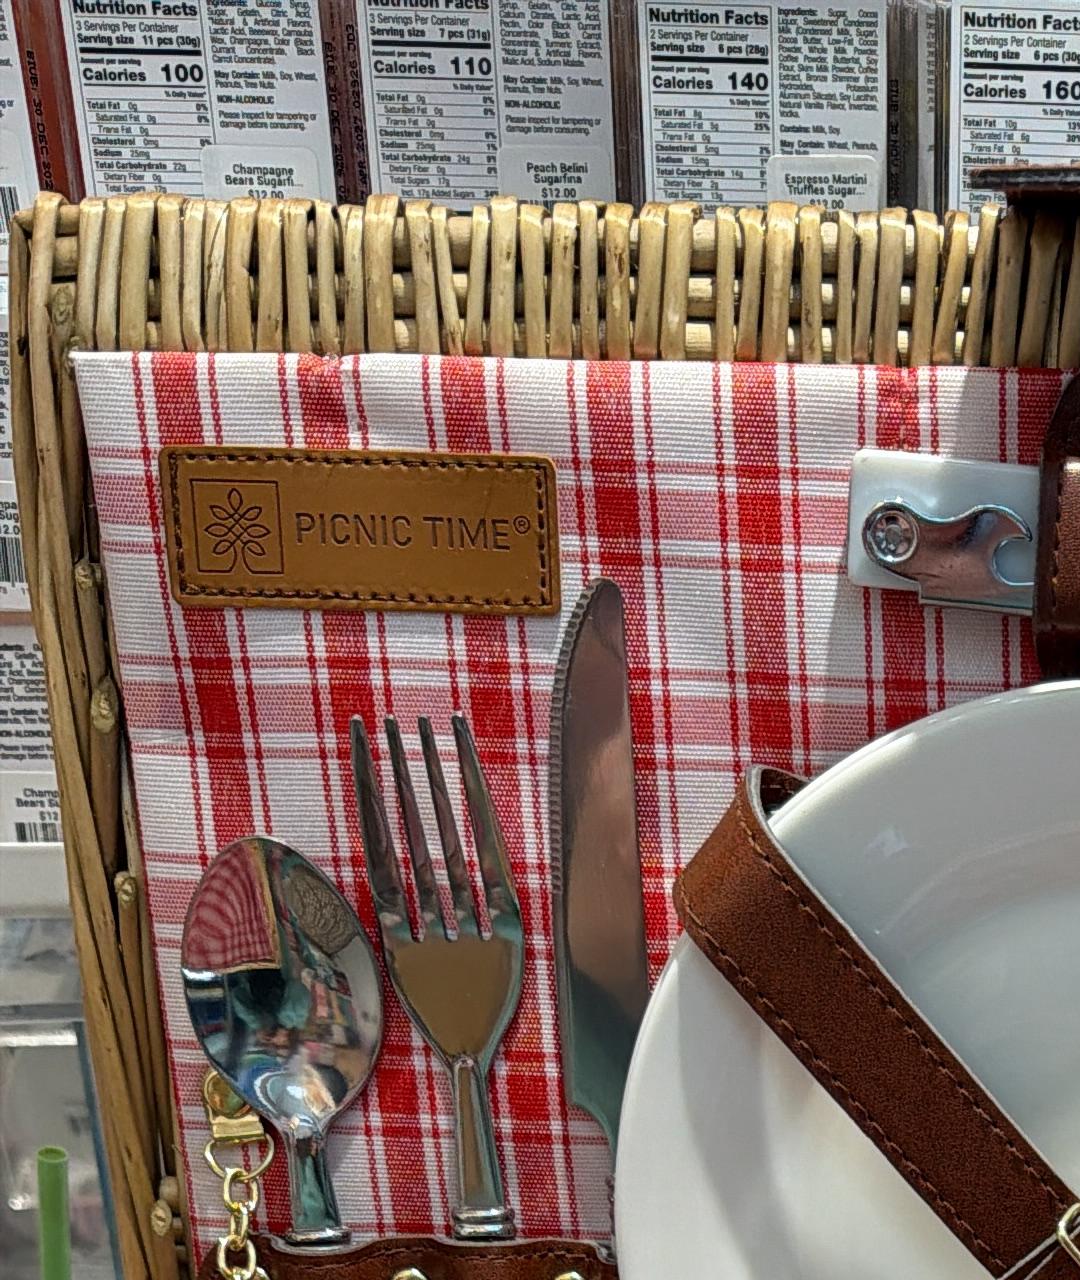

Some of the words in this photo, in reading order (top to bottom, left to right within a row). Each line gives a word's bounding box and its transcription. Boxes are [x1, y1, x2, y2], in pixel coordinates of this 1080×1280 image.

[73, 0, 146, 14] Nutrition
[152, 1, 197, 16] Facts
[370, 13, 375, 23] 3
[377, 14, 413, 26] Servings
[415, 14, 428, 25] Per
[431, 15, 470, 26] Container
[649, 8, 719, 24] Nutrition
[724, 10, 769, 25] Facts
[964, 12, 1037, 29] Nutrition
[76, 21, 82, 31] 3
[84, 21, 120, 33] Servings
[122, 22, 136, 32] Per
[140, 22, 179, 33] Container
[370, 26, 404, 38] Serving
[407, 27, 426, 37] size
[448, 30, 464, 40] pcs
[467, 29, 490, 41] (31g)
[77, 34, 113, 46] Serving
[116, 35, 134, 44] size
[143, 35, 153, 45] 11
[157, 37, 173, 47] pcs
[176, 36, 200, 48] (30g)
[650, 29, 656, 39] 2
[658, 29, 693, 42] Servings
[695, 30, 708, 40] Per
[711, 31, 749, 42] Container
[964, 35, 970, 45] 2
[972, 35, 1008, 48] Servings
[1010, 36, 1024, 46] Per
[1026, 37, 1067, 48] Container
[650, 41, 684, 54] Serving
[687, 42, 705, 53] size
[727, 45, 743, 55] pcs
[964, 48, 999, 60] Serving
[1001, 48, 1020, 59] size
[1033, 50, 1040, 60] 6
[1042, 51, 1059, 62] pcs
[83, 68, 146, 81] Calories
[161, 64, 203, 82] 100
[373, 60, 436, 74] Calories
[450, 57, 492, 75] 110
[652, 75, 713, 90] Calories
[728, 72, 769, 90] 140
[963, 83, 1027, 99] Calories
[87, 101, 106, 109] Total
[108, 101, 120, 109] Fat
[963, 118, 982, 127] Total
[984, 119, 996, 127] Fat
[232, 163, 294, 177] Champagne
[526, 162, 557, 173] Peach
[42, 161, 54, 192] 202
[225, 175, 254, 185] Bears
[534, 174, 583, 186] Sugarfina
[785, 174, 830, 185] Espresso
[832, 173, 867, 184] Martini
[541, 188, 576, 199] $12.00
[788, 185, 825, 195] Truffles
[295, 513, 412, 548] PICNIC
